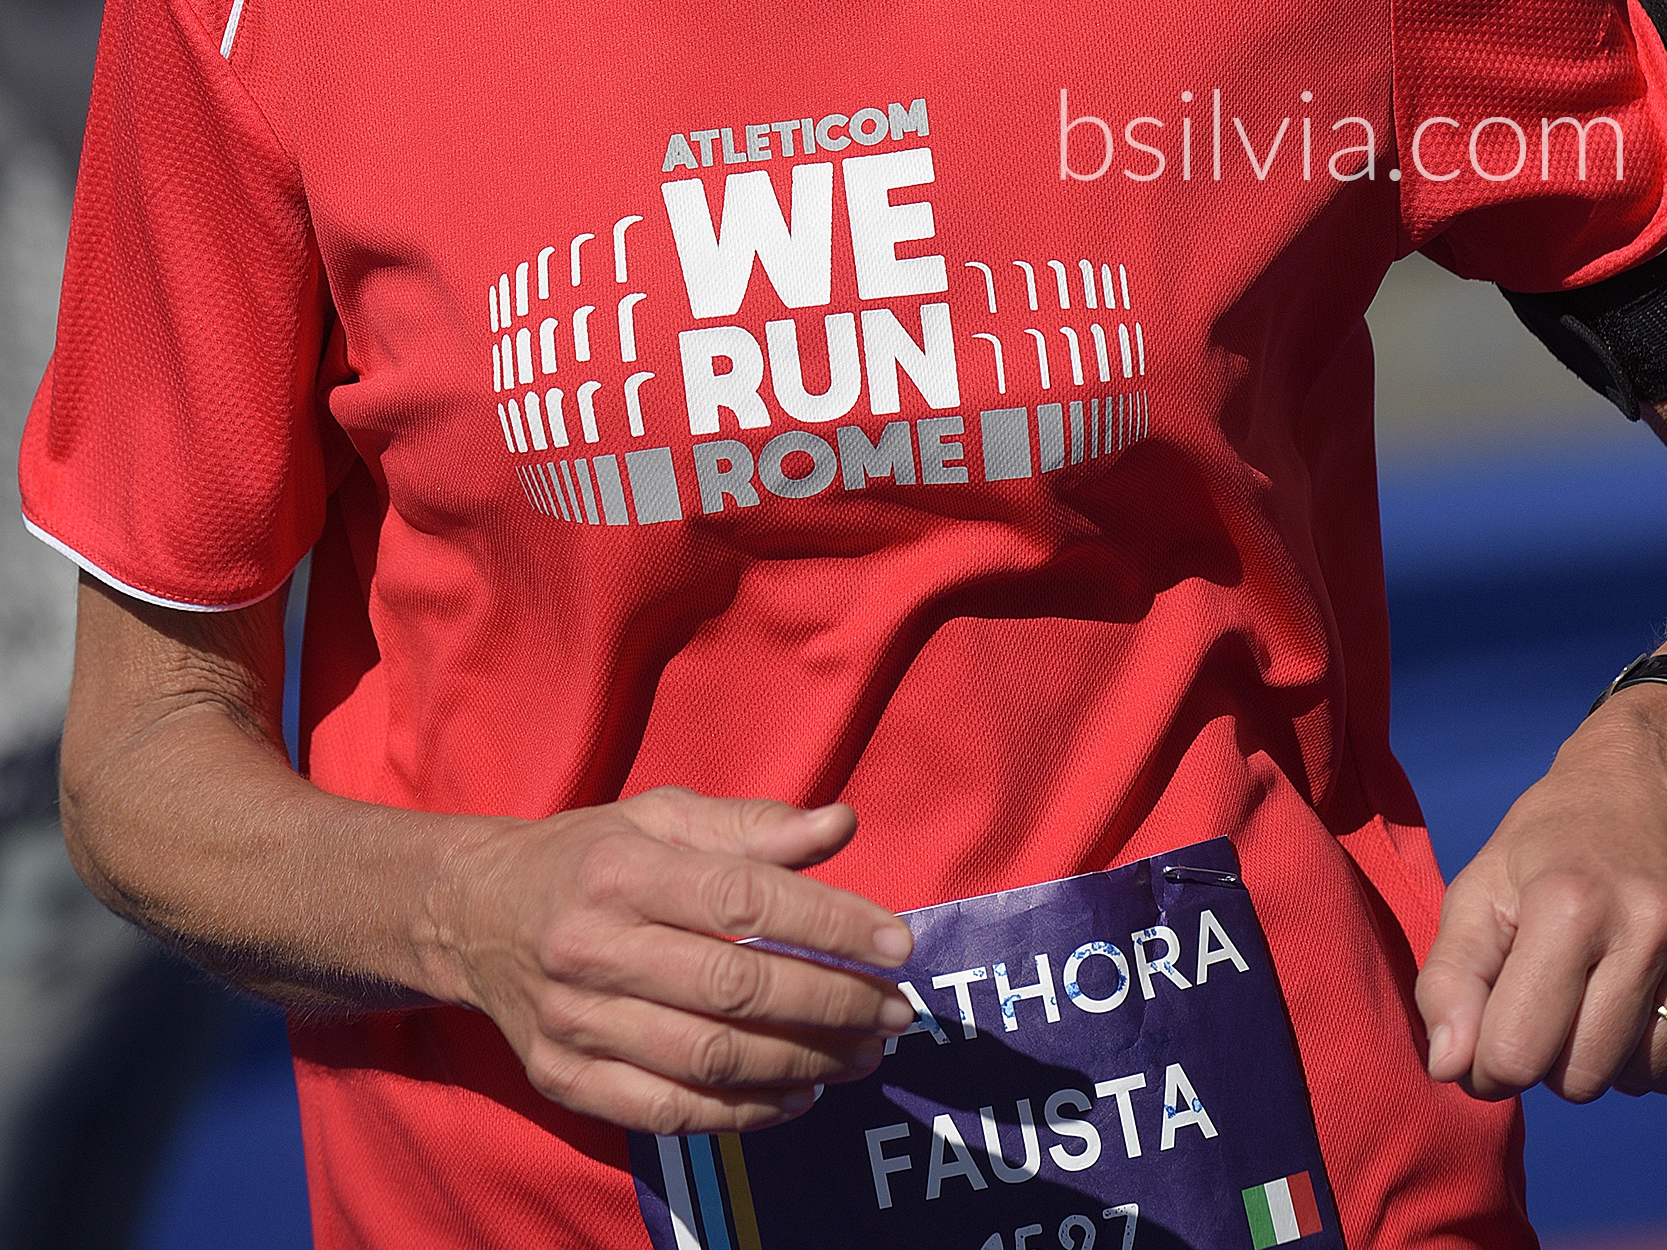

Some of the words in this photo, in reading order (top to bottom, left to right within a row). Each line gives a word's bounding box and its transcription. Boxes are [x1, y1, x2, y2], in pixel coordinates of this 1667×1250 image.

[661, 98, 930, 172] ATLETICOM
[660, 147, 949, 319] WE
[678, 302, 961, 436] RUN
[693, 416, 969, 514] ROME
[883, 909, 1250, 1057] ATHORA
[864, 1062, 1218, 1210] FAUSTA
